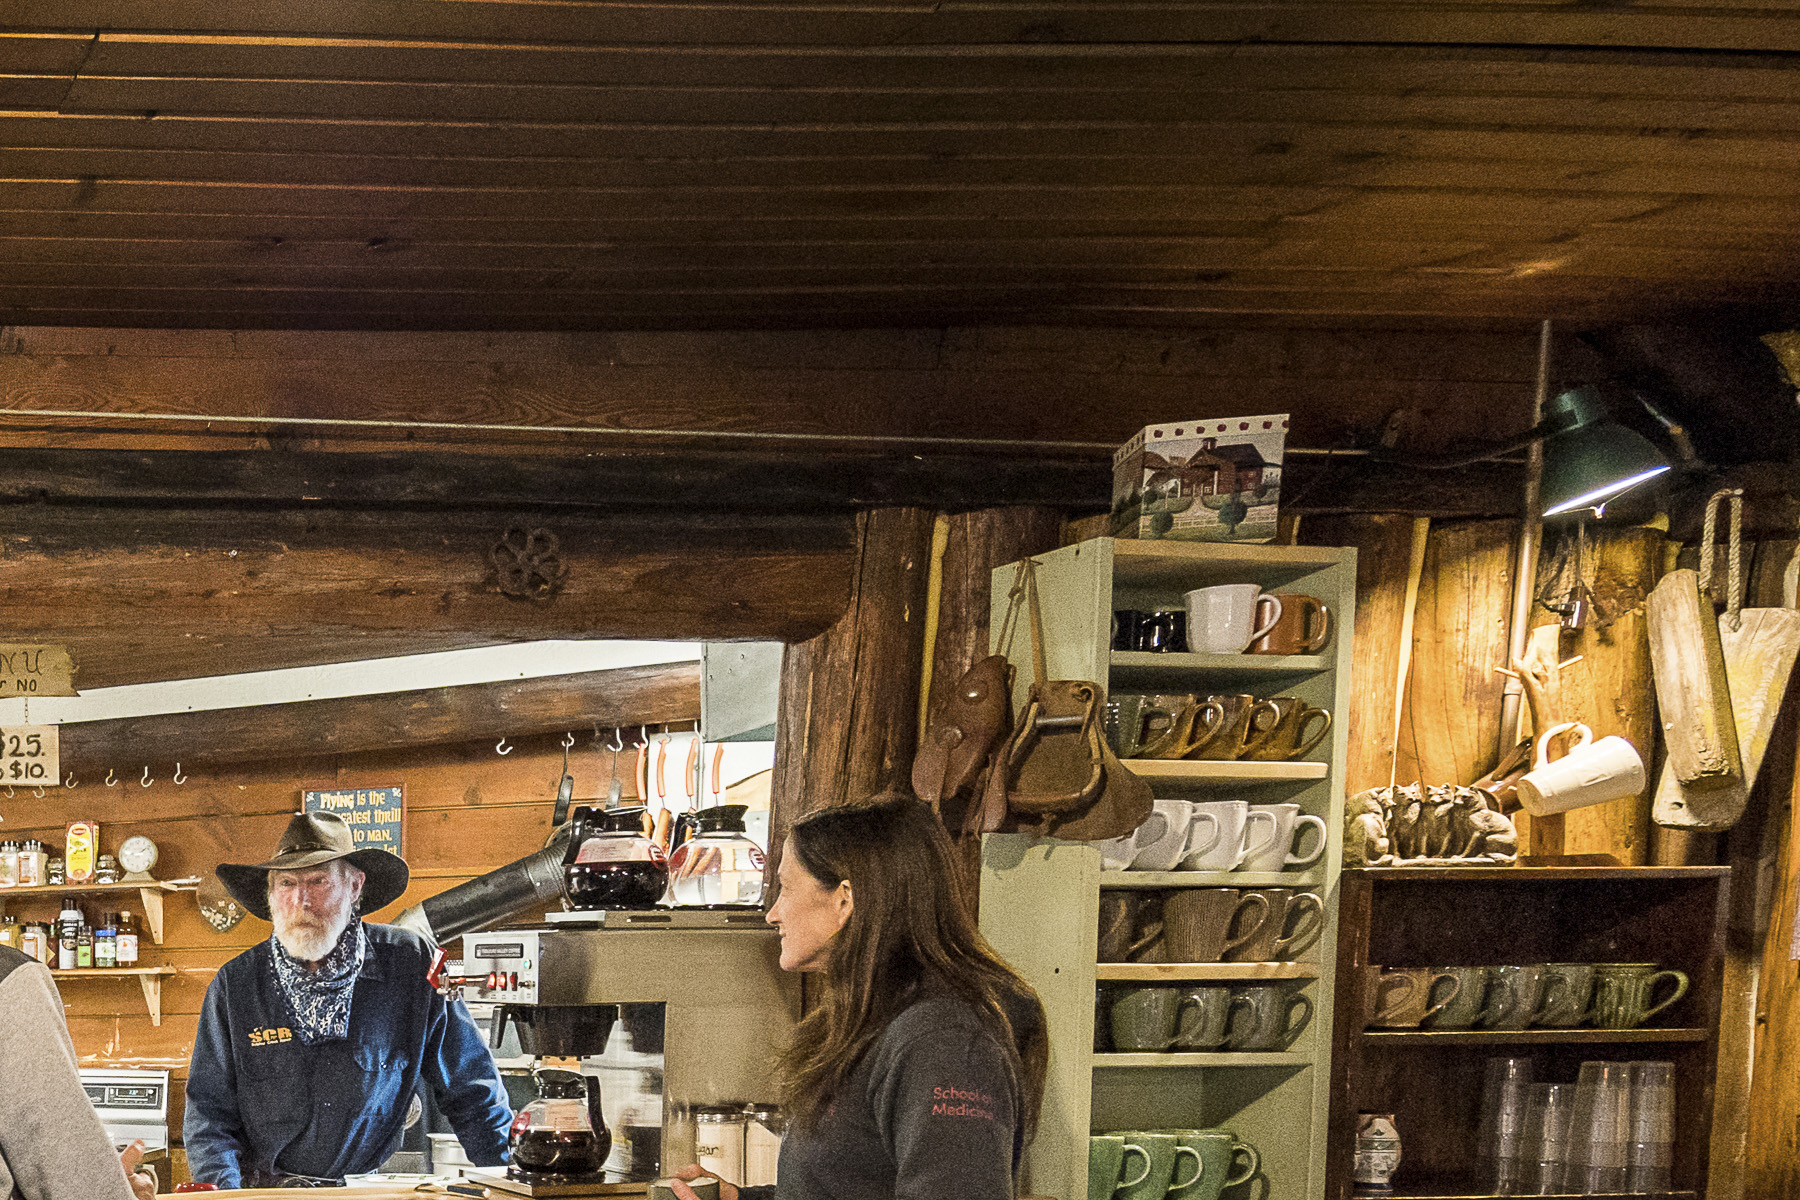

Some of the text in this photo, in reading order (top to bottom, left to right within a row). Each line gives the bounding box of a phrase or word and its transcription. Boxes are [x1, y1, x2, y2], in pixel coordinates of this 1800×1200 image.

[17, 678, 37, 692] NO
[9, 759, 49, 780] $10.
[356, 790, 366, 806] is
[368, 790, 386, 808] the
[374, 807, 401, 825] thrill
[353, 828, 365, 843] to
[248, 1028, 292, 1044] SCR
[933, 1086, 980, 1101] School
